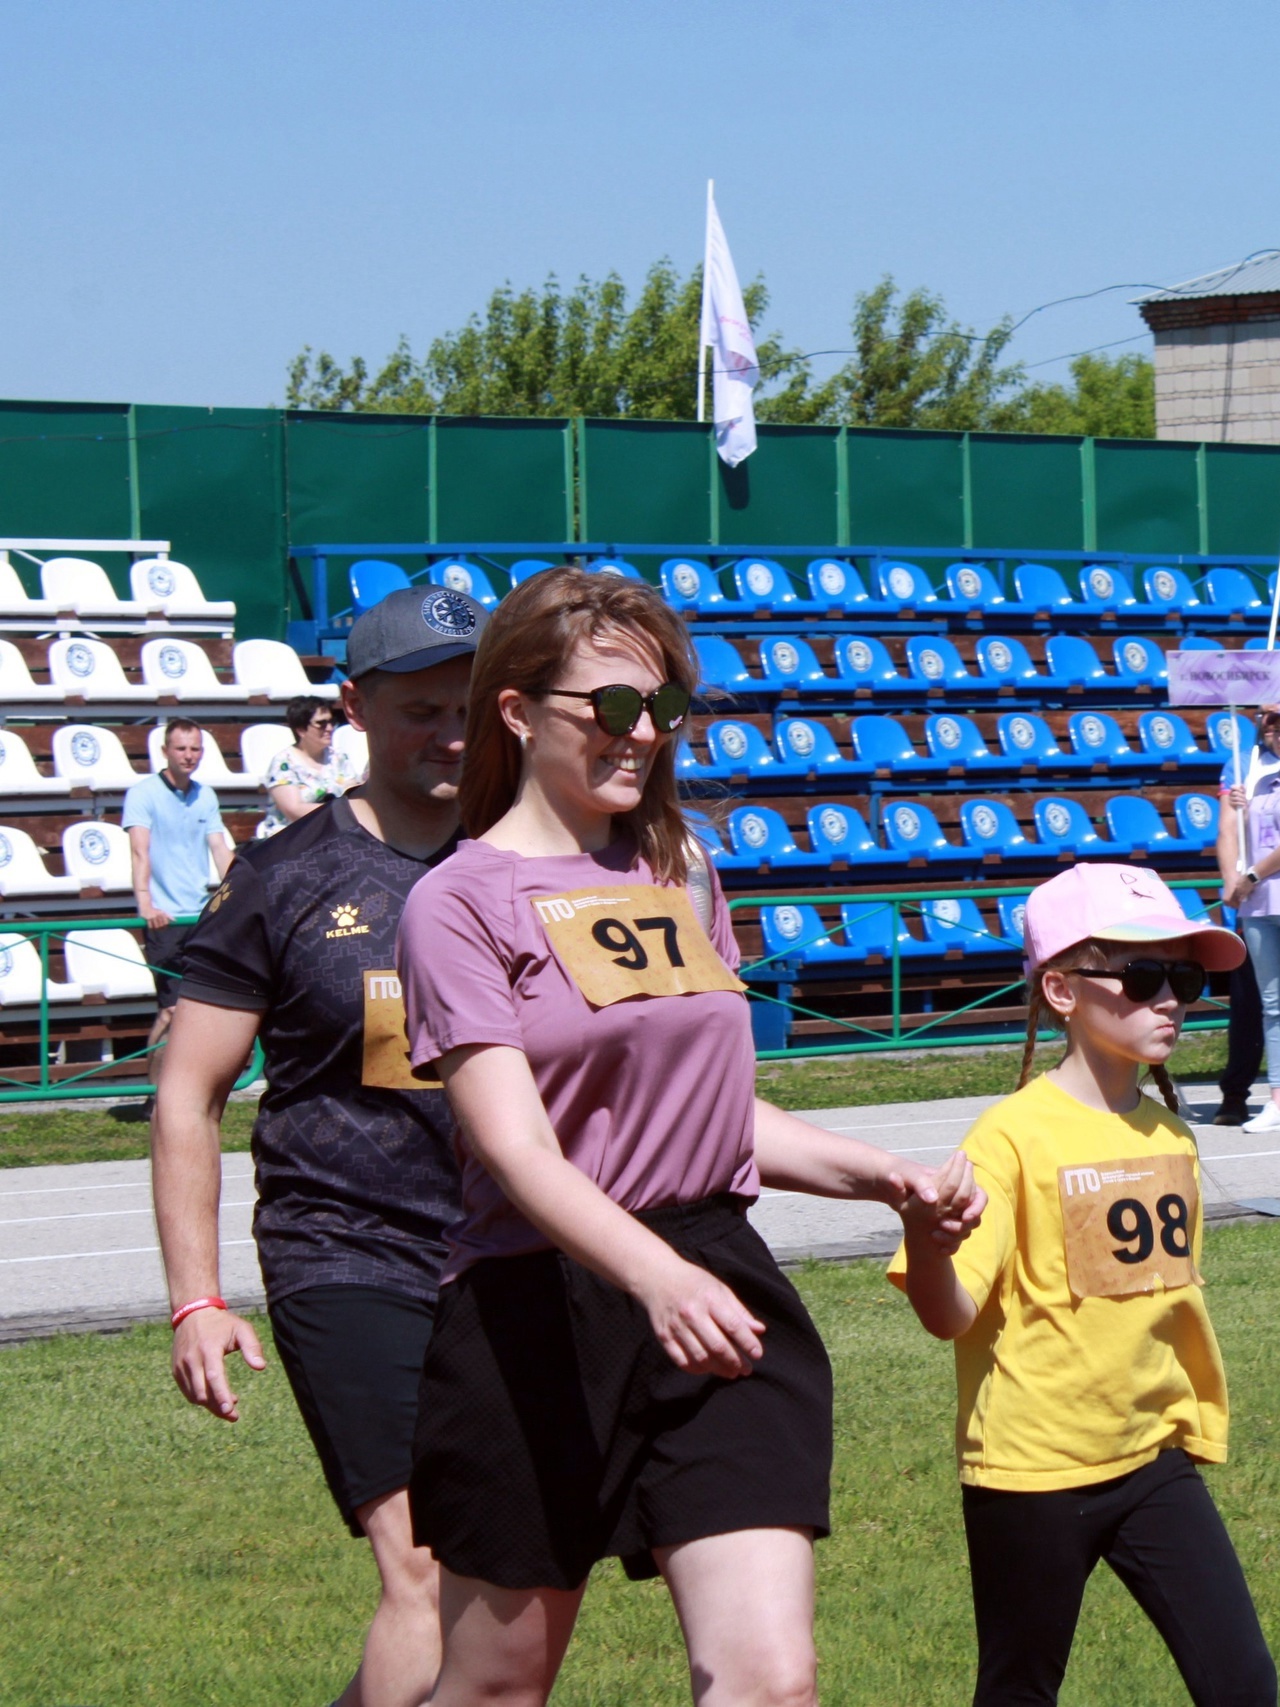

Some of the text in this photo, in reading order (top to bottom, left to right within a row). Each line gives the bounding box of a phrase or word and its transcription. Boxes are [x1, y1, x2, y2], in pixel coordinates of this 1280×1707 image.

[326, 925, 370, 939] KELME
[592, 917, 686, 970] 97
[1107, 1193, 1190, 1264] 98
